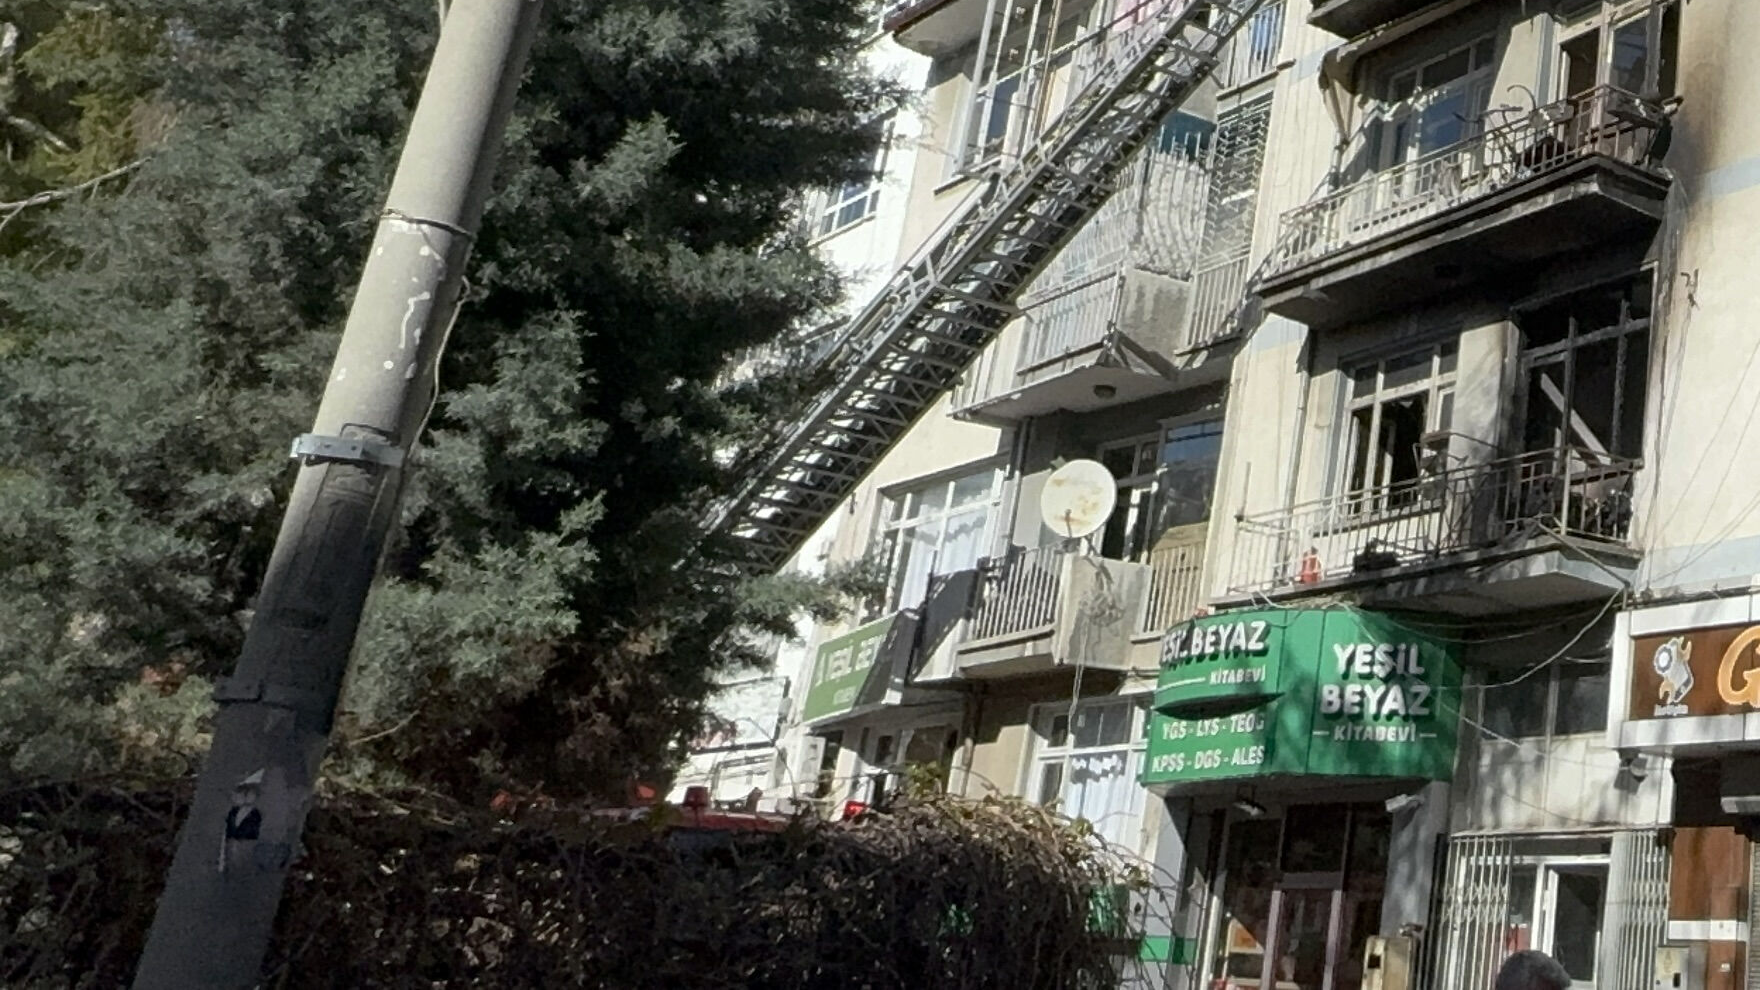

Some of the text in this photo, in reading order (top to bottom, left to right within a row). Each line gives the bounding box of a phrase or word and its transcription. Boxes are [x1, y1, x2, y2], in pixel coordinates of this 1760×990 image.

[1191, 620, 1267, 657] BEYAZ
[1209, 664, 1266, 685] KİTABEVİ
[1333, 642, 1425, 679] YEŞİL
[1320, 683, 1431, 715] BEYAZ
[1162, 721, 1187, 740] YGS
[1196, 718, 1220, 737] LYS
[1333, 721, 1417, 742] KİTABEVİ
[1152, 745, 1265, 773] KPSS DGS ALES
